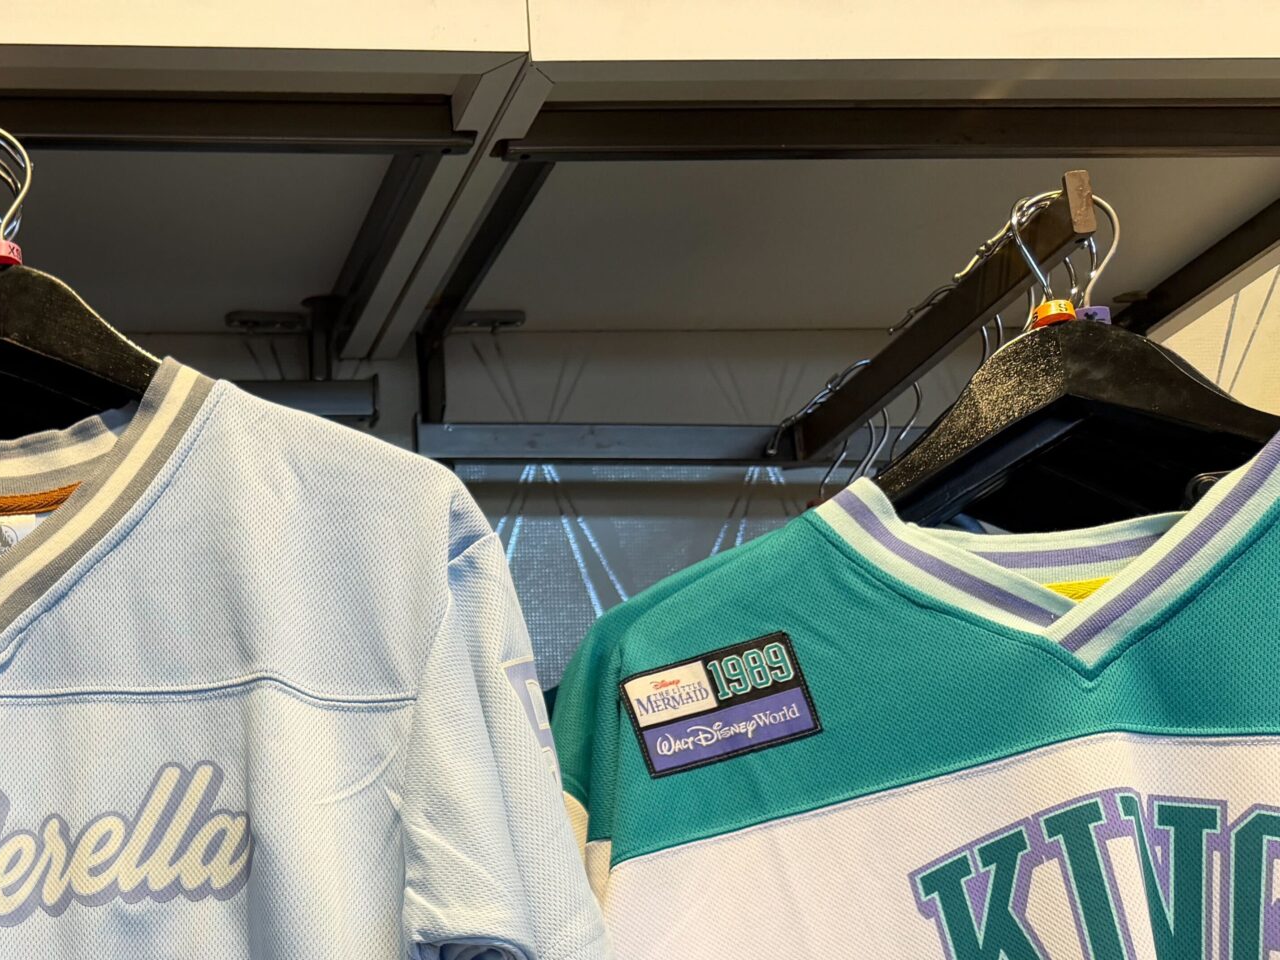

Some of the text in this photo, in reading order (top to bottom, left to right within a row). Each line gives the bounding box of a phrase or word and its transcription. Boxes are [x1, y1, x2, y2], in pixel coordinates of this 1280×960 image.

[707, 642, 794, 700] 1989
[635, 688, 709, 716] MERMAID
[653, 681, 702, 699] THE LITTLE
[753, 704, 800, 727] World
